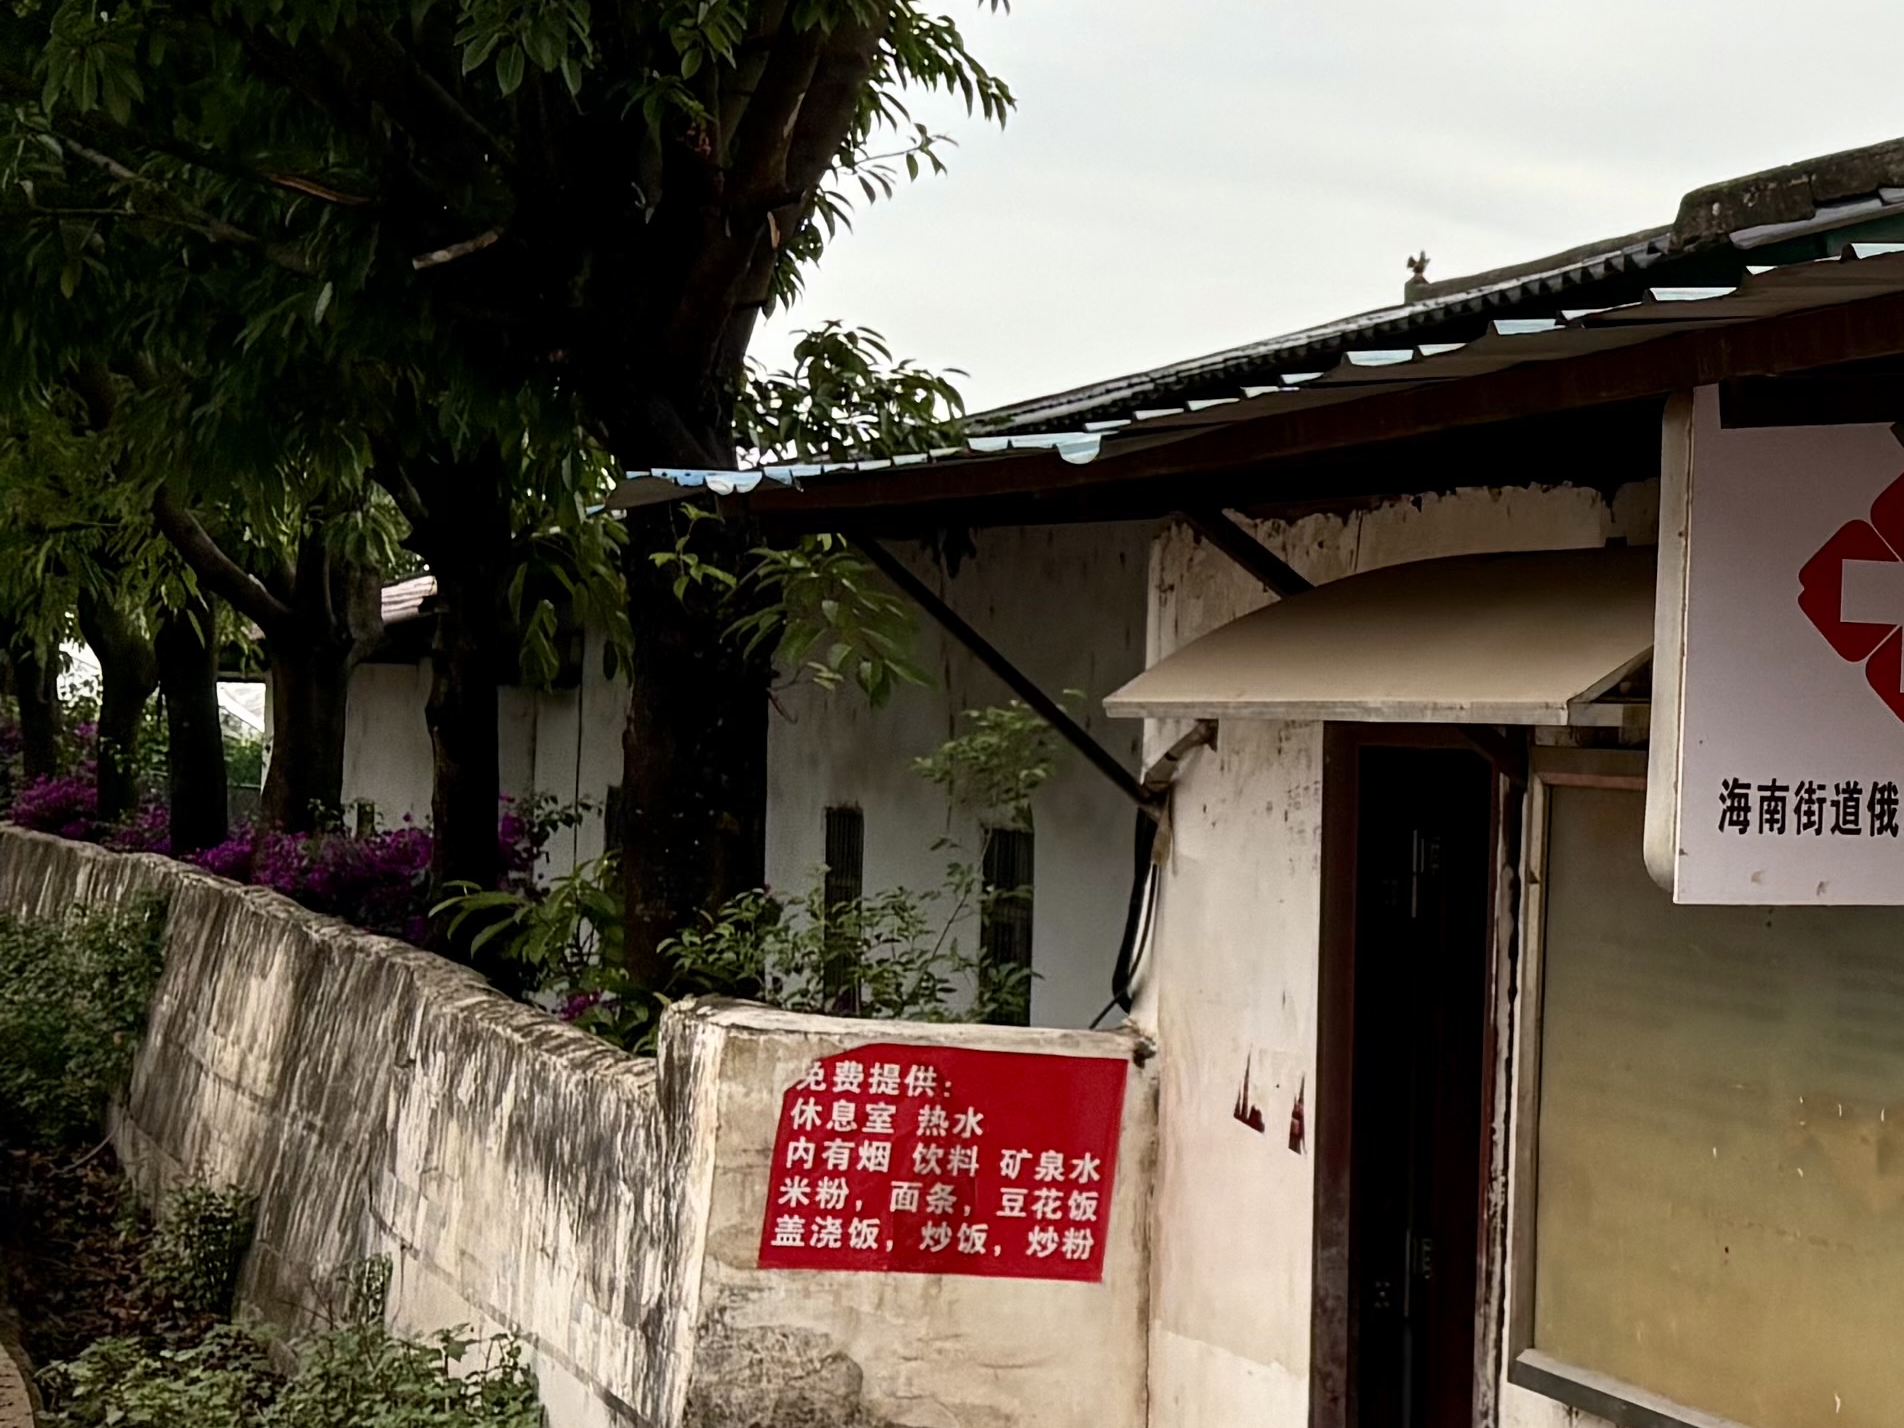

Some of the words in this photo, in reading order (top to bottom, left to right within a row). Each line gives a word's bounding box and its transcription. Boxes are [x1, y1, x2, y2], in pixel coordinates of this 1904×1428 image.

[790, 1097, 896, 1134] 休息室
[917, 1105, 985, 1139] 热水
[786, 1137, 891, 1174] 内有烟
[912, 1143, 980, 1178] 饮料
[999, 1148, 1102, 1184] 矿泉水
